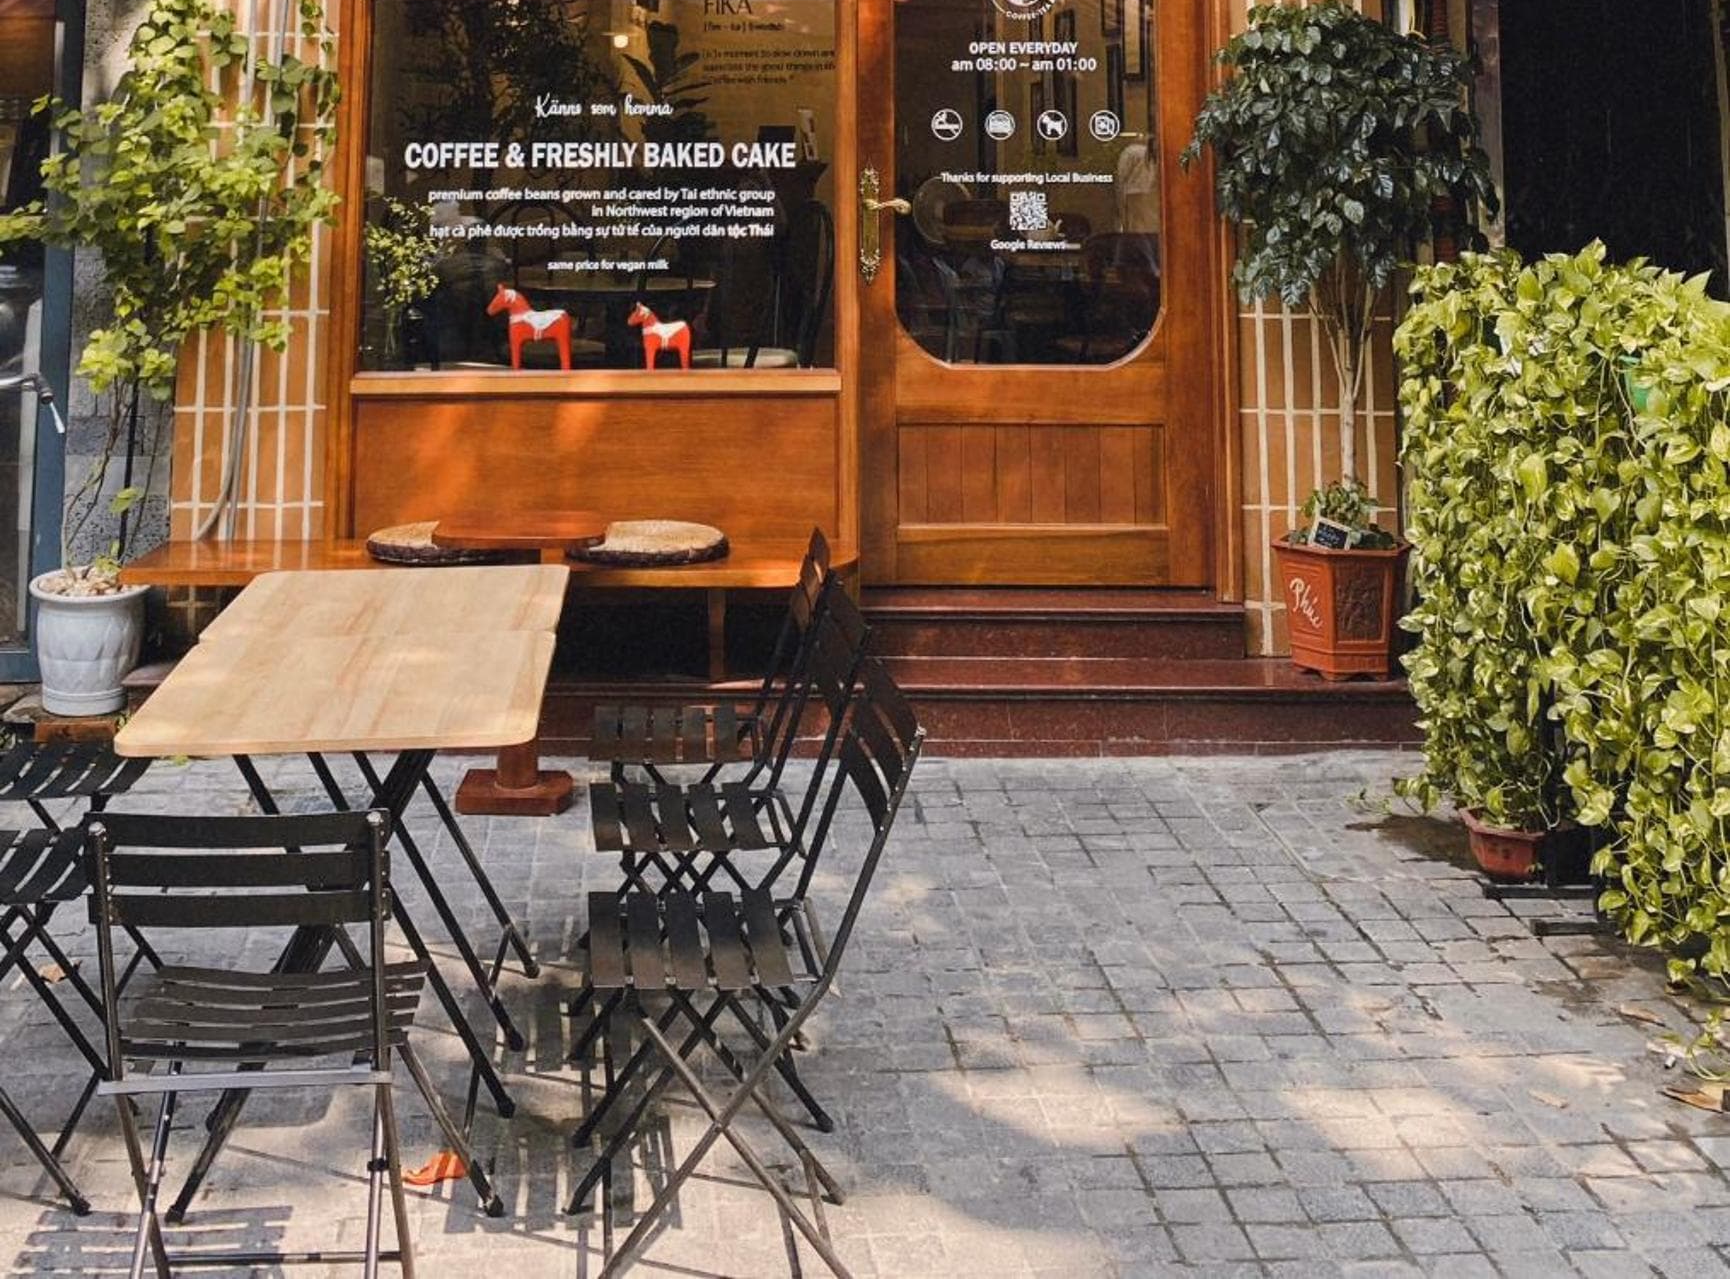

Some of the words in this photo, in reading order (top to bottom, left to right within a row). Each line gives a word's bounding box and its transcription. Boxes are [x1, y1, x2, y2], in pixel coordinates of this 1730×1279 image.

[969, 41, 1006, 55] OPEN
[1009, 41, 1078, 55] EVERYDAY
[951, 60, 973, 71] am
[976, 58, 1016, 71] 08:00
[1032, 60, 1053, 71] am
[1056, 58, 1097, 71] 01:00
[591, 103, 617, 116] som
[624, 94, 675, 116] hemma
[404, 142, 499, 169] COFFEE
[504, 142, 525, 169] &
[532, 142, 638, 169] FRESHLY
[644, 142, 725, 169] BAKED
[731, 142, 796, 169] CAKE
[941, 172, 974, 183] Thanks
[976, 172, 990, 183] for
[991, 172, 1044, 185] supporting
[1045, 172, 1071, 183] Local
[1073, 172, 1113, 183] Business
[428, 189, 483, 202] premium
[485, 188, 522, 200] coffee
[525, 188, 560, 200] beans
[562, 190, 600, 203] grown
[603, 187, 626, 200] and
[628, 187, 661, 200] cared
[664, 187, 679, 202] by
[680, 188, 697, 200] Tai
[700, 187, 737, 200] ethnic
[739, 190, 775, 202] group
[591, 205, 603, 217] in
[605, 205, 667, 217] Northwest
[670, 205, 708, 219] region
[711, 205, 723, 217] of
[725, 205, 774, 217] Vietnam
[990, 239, 1025, 252] Google
[547, 261, 573, 270] same
[575, 259, 599, 272] price
[600, 259, 614, 270] for
[616, 261, 645, 272] vegan
[648, 258, 669, 270] milk
